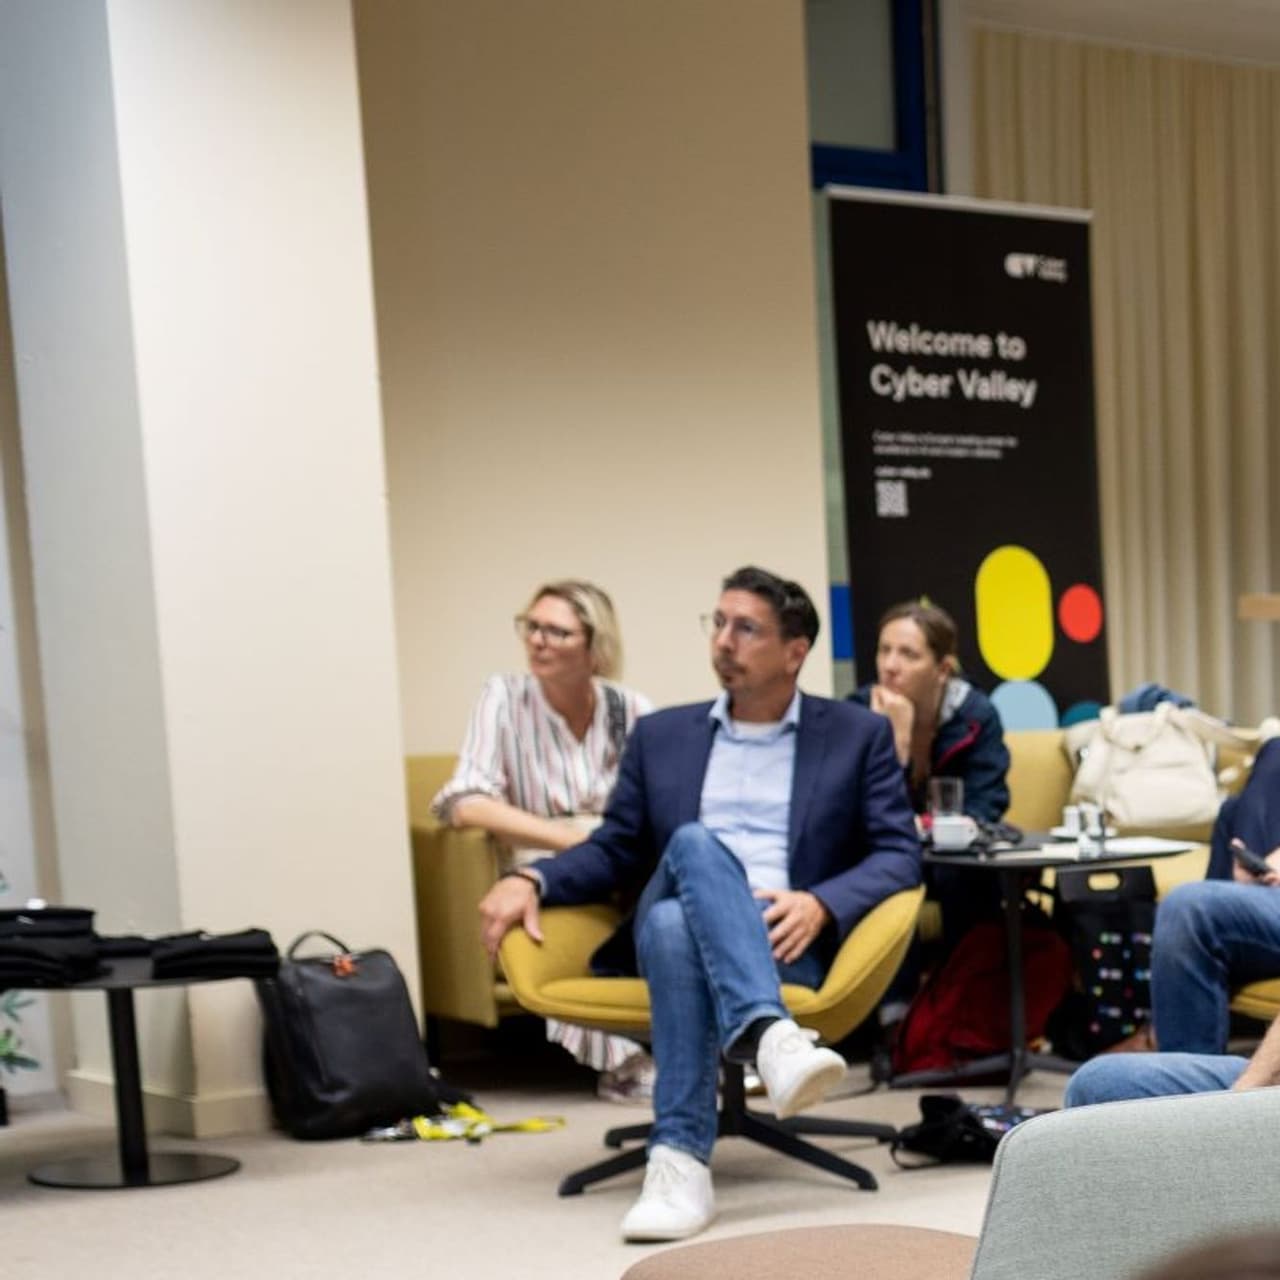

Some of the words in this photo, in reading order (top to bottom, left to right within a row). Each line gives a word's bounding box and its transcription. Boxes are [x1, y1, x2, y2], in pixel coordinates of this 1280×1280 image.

[867, 320, 993, 359] Welcome
[996, 332, 1027, 361] to
[870, 363, 954, 402] Cyber
[957, 368, 1038, 409] Valley
